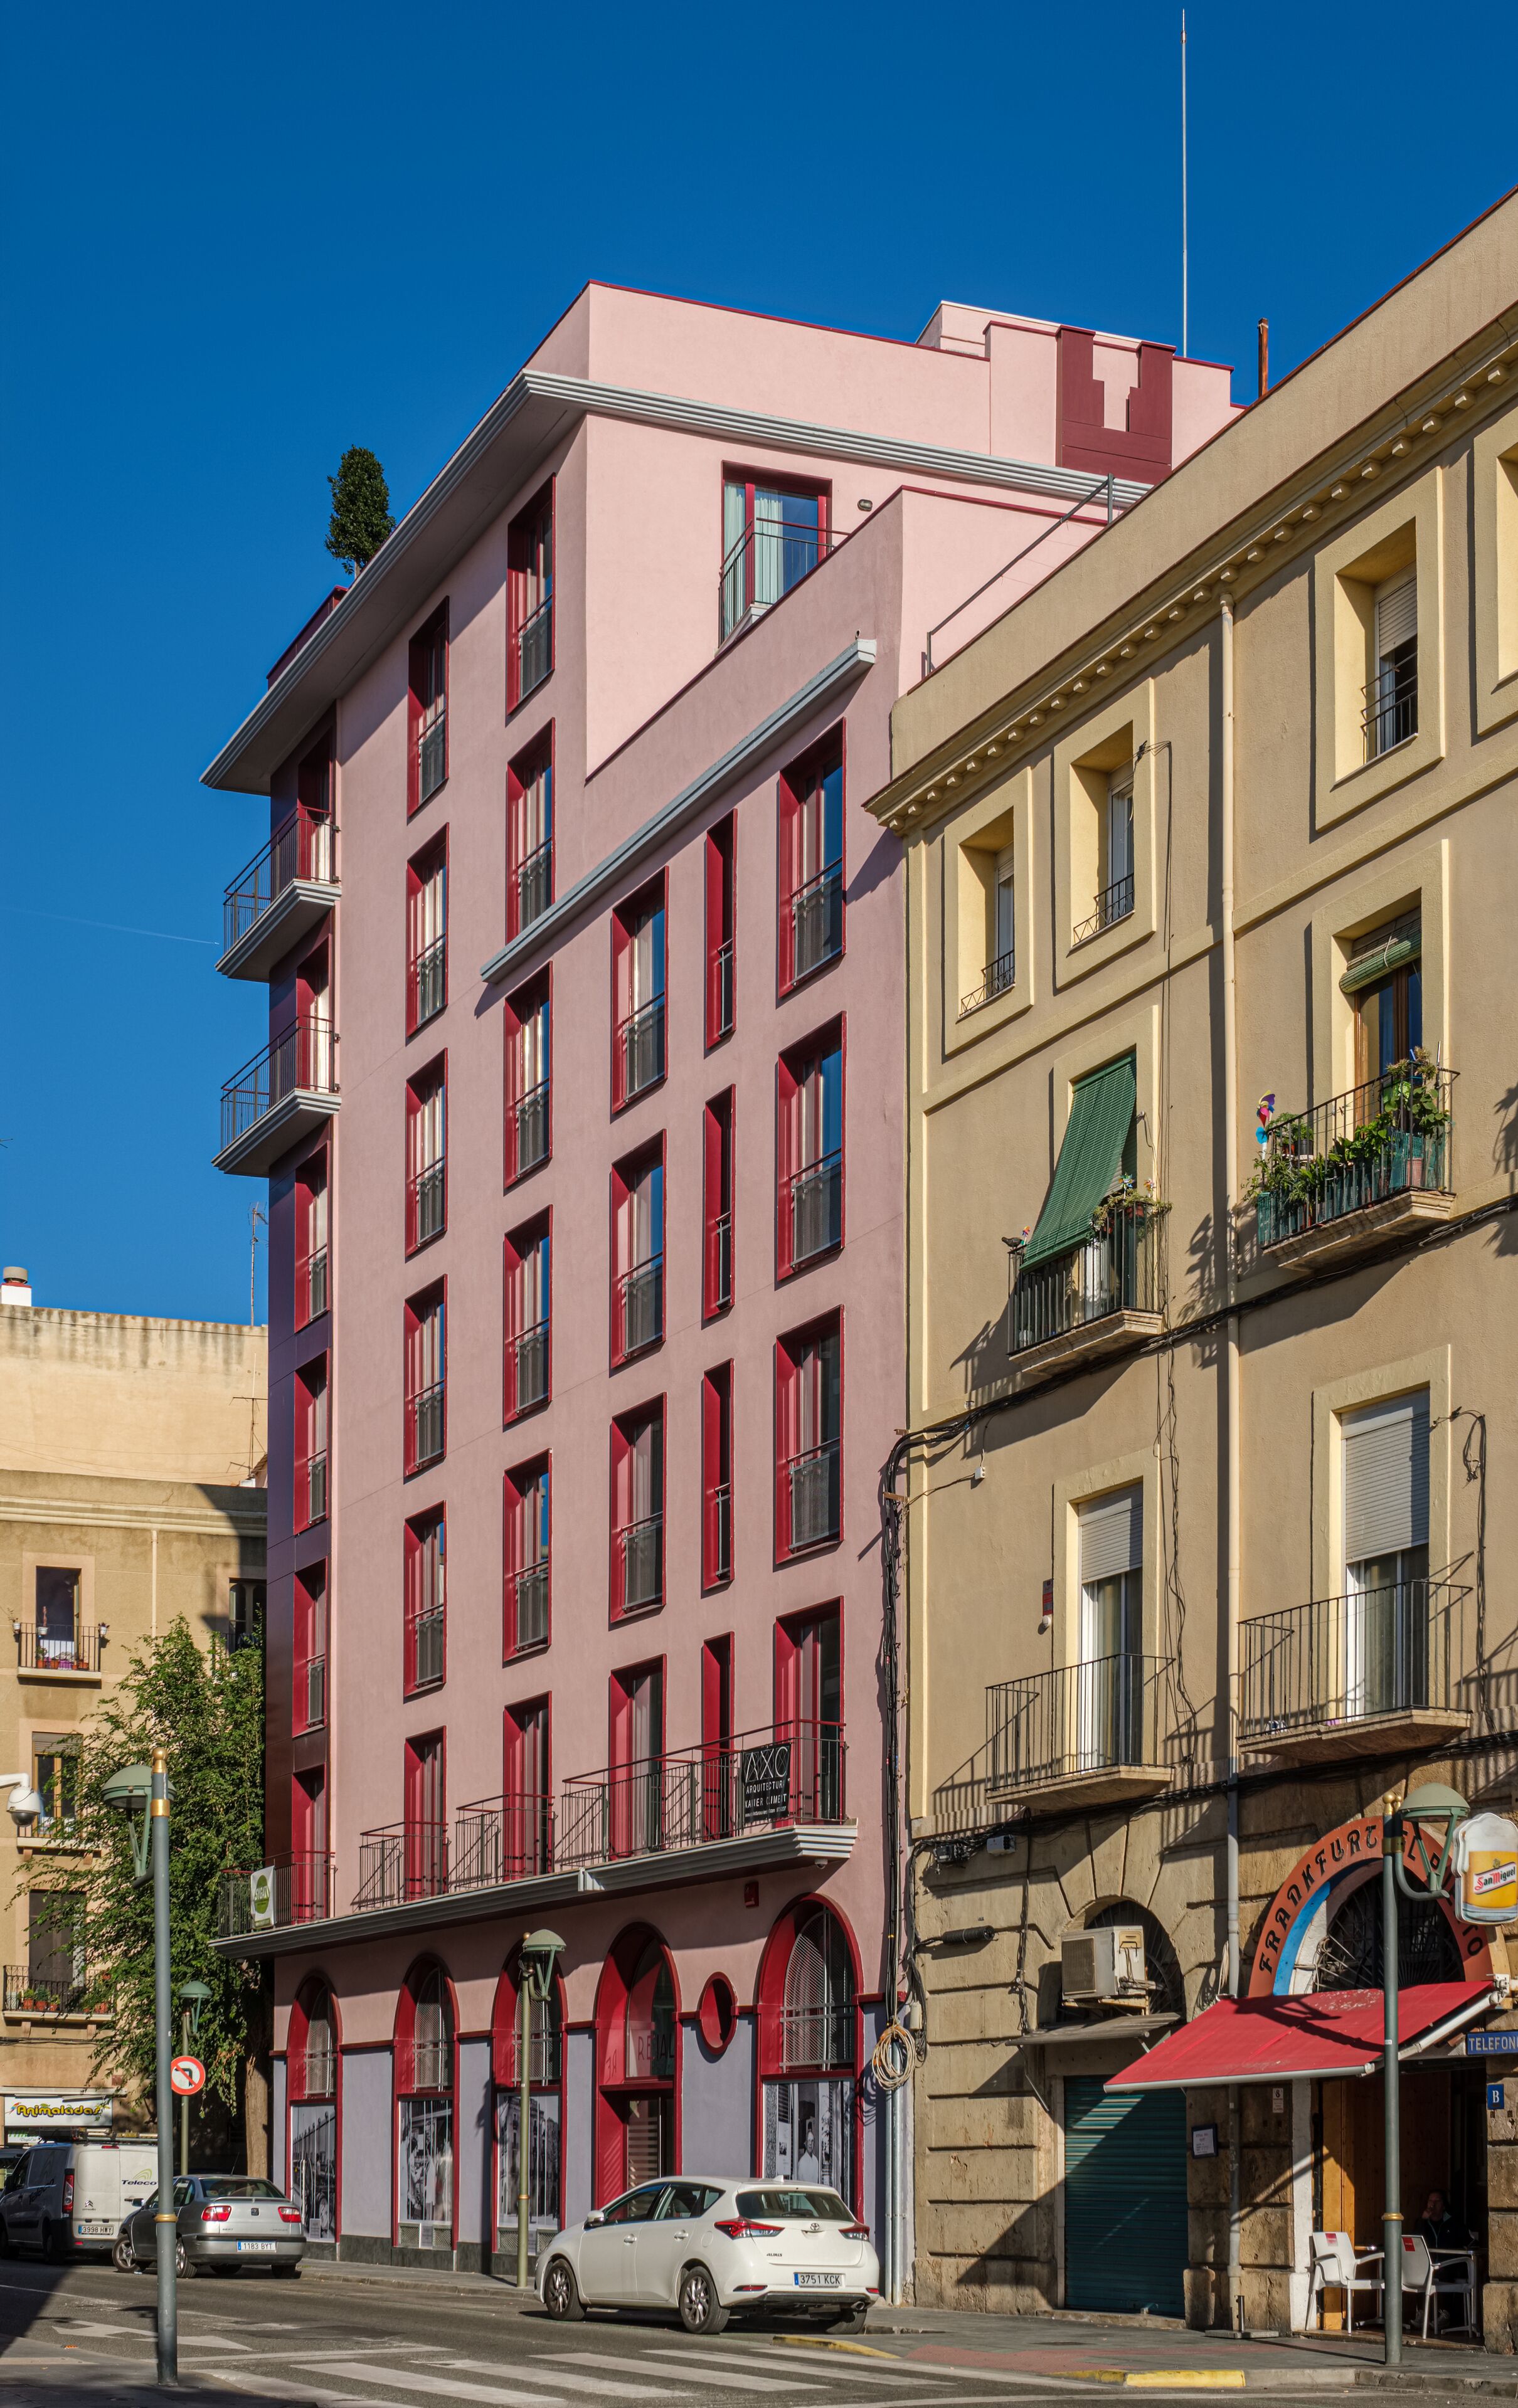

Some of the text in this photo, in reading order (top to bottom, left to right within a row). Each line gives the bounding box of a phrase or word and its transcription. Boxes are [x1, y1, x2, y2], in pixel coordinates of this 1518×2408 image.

[745, 1746, 788, 1782] AXC
[766, 1793, 787, 1805] CIMET
[1259, 1824, 1377, 1974] FRANKFURT
[1468, 2036, 1518, 2051] TELEFON
[1492, 2089, 1500, 2103] B
[16, 2104, 101, 2117] Animaladas
[800, 2274, 841, 2285] 3751 KCK
